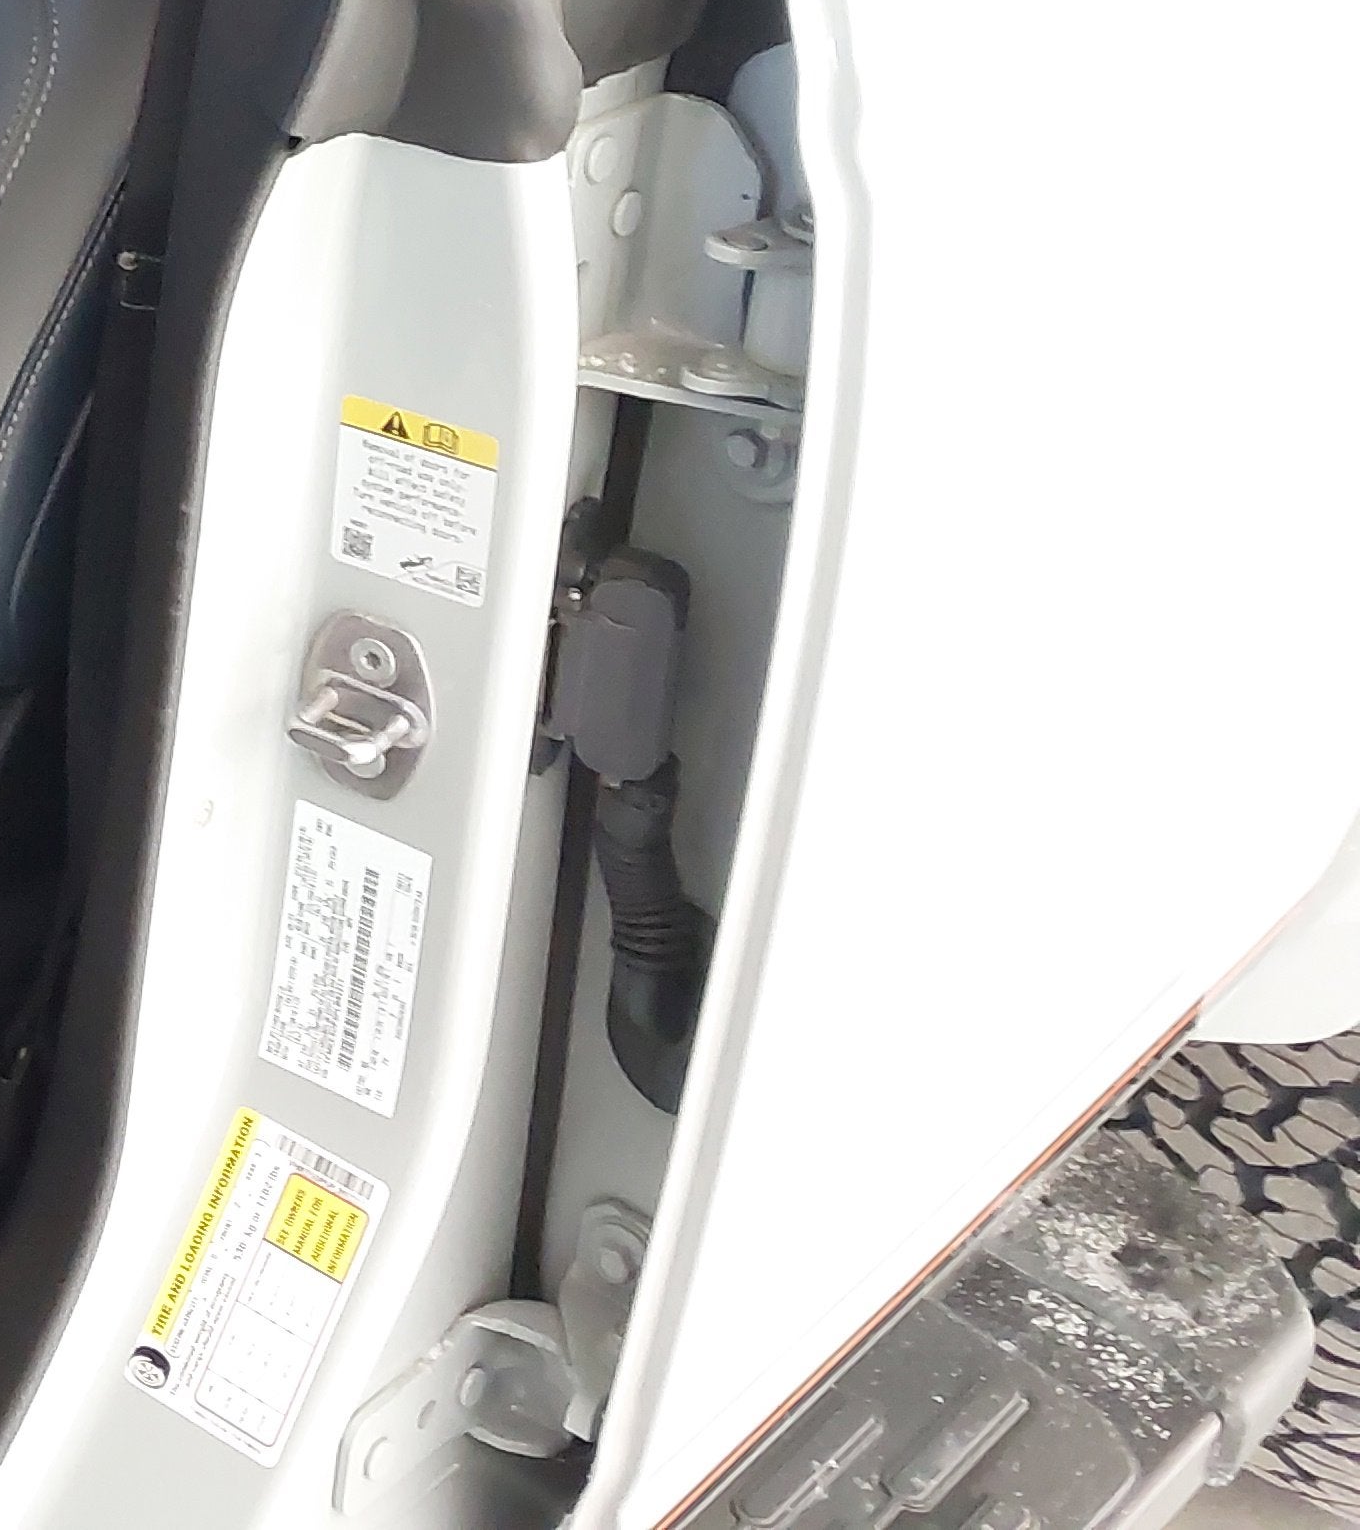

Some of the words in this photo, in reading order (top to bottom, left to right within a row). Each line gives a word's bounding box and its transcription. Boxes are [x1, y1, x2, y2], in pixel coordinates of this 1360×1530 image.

[151, 1304, 173, 1336] TIRE
[167, 1273, 186, 1303] AND
[180, 1212, 215, 1272] LOADING
[207, 1116, 254, 1210] INFORMATION
[292, 1218, 316, 1256] MANUAL
[326, 1212, 359, 1274] INFORMATION
